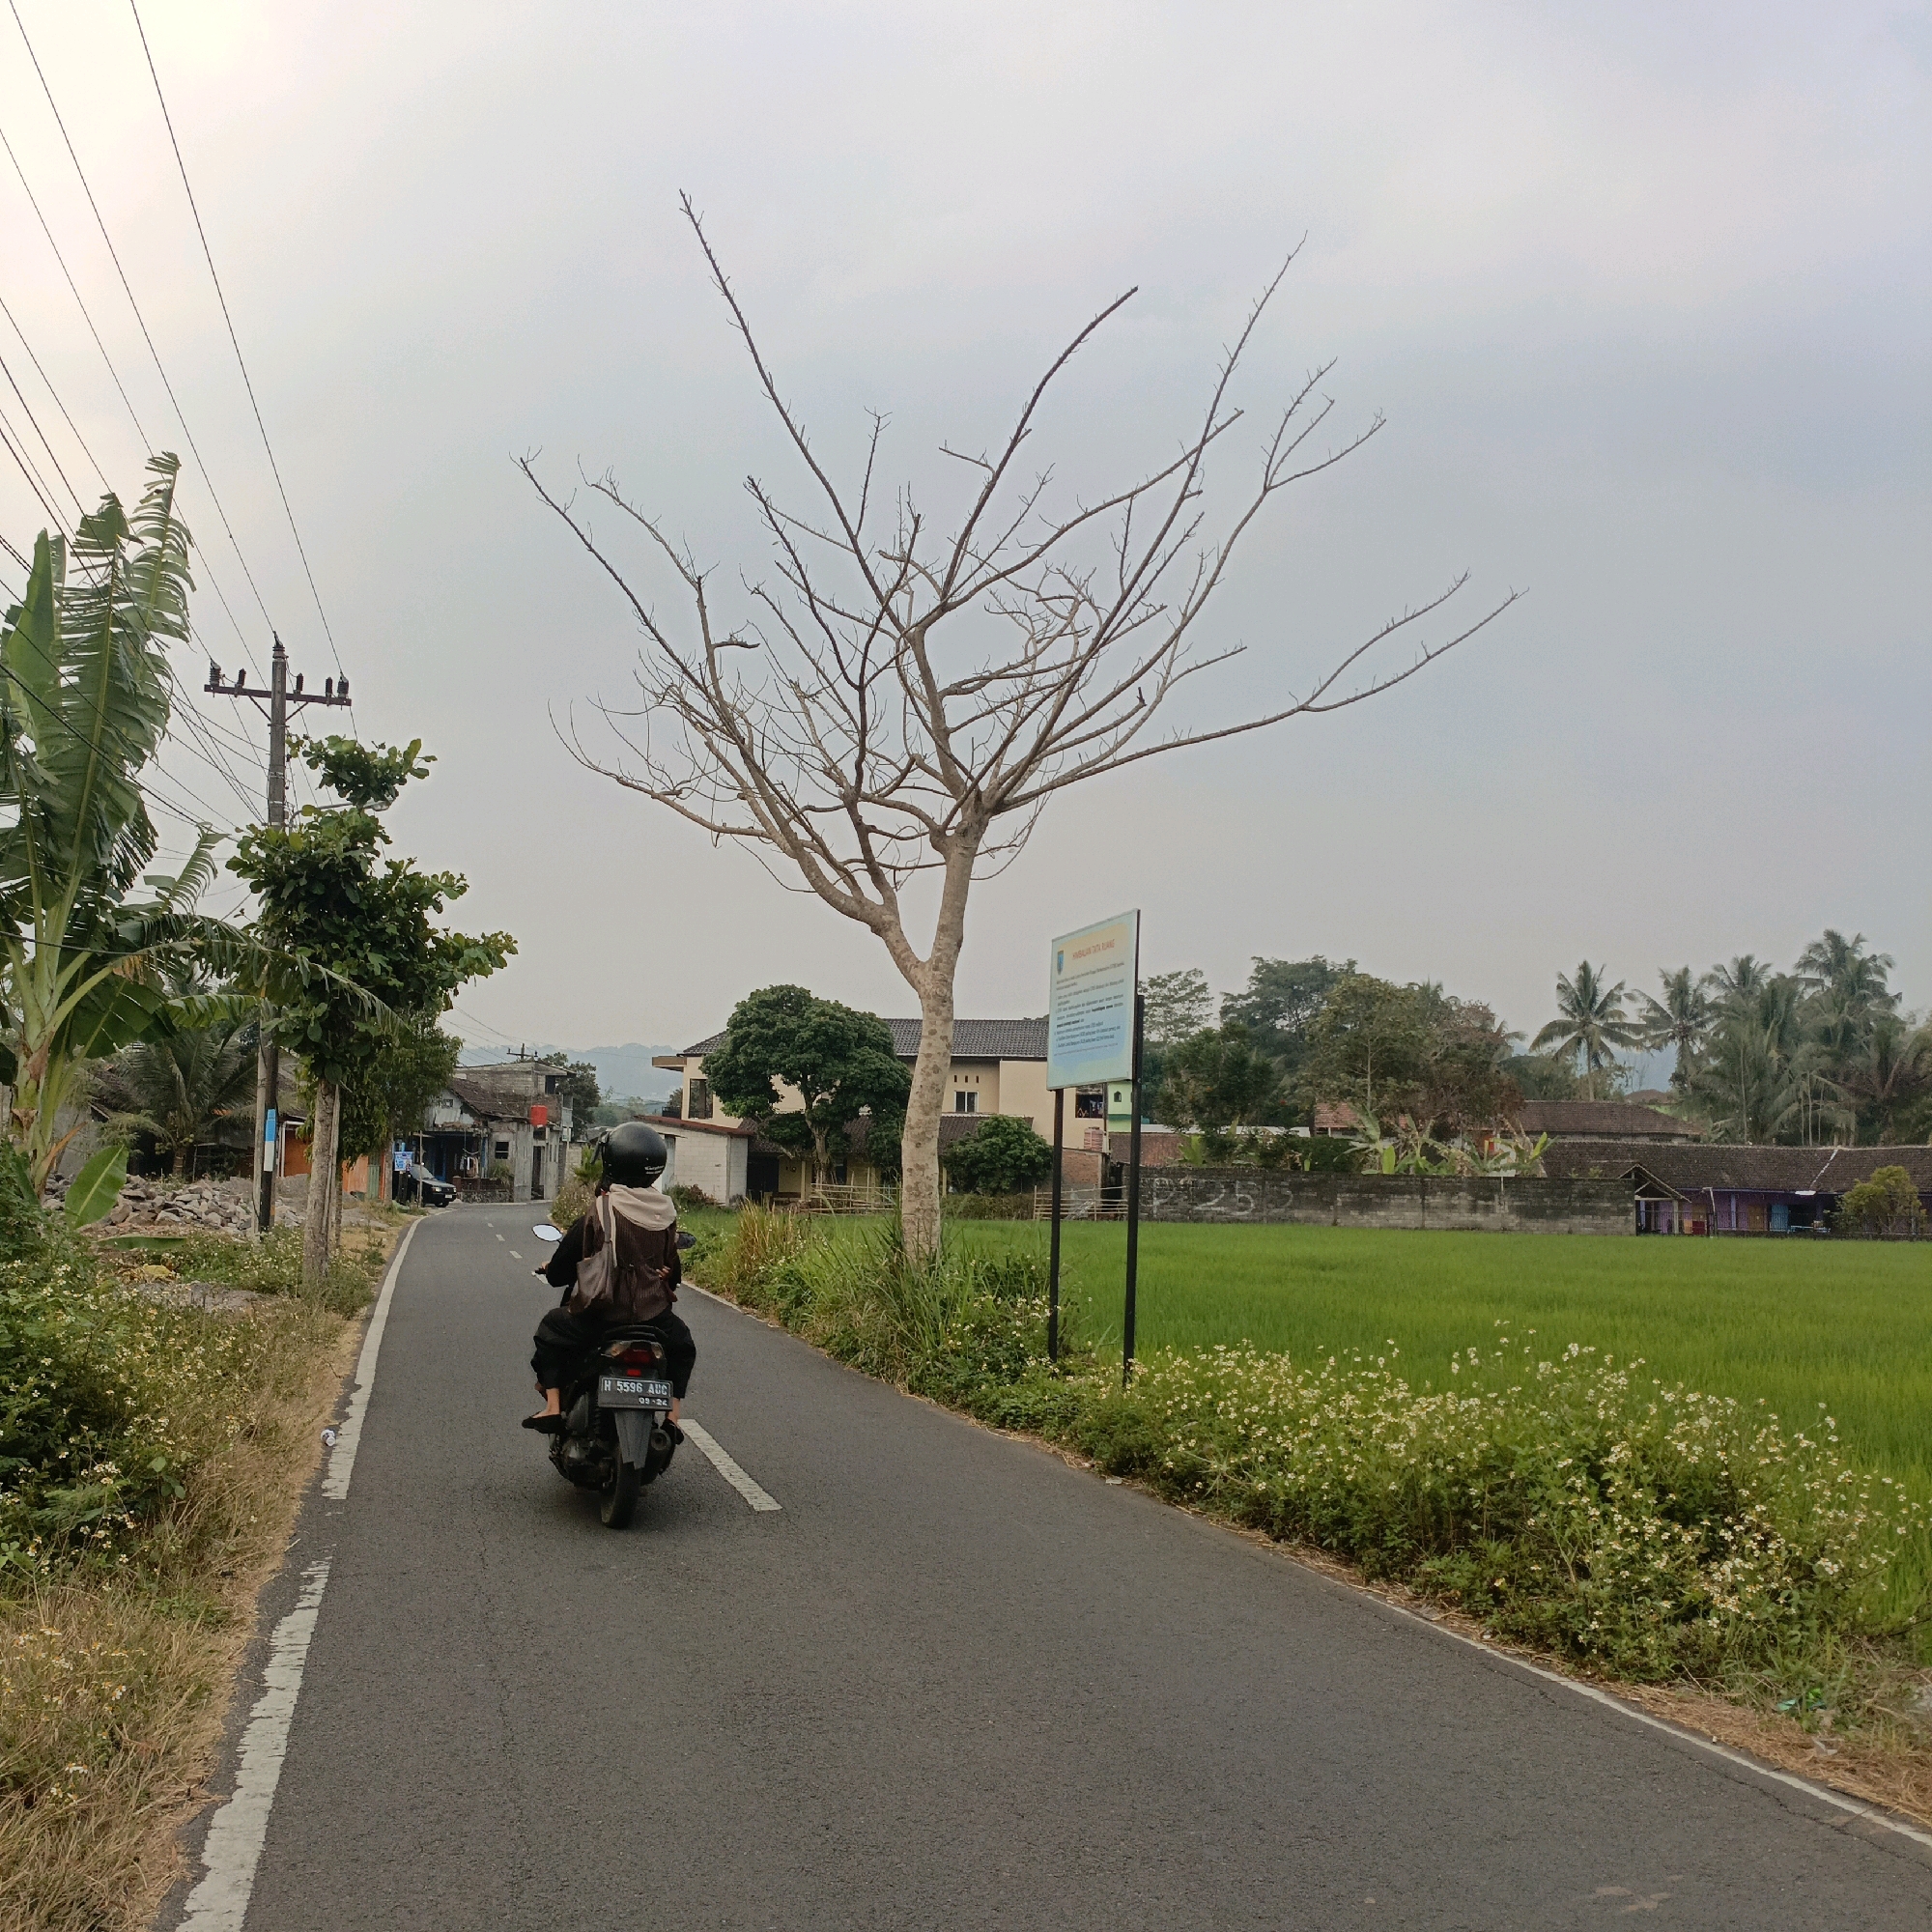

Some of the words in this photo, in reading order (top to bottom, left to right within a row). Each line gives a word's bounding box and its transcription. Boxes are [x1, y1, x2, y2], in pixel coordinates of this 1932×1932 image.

[604, 1380, 611, 1391] H
[616, 1381, 642, 1393] 5596
[648, 1383, 668, 1395] AUC
